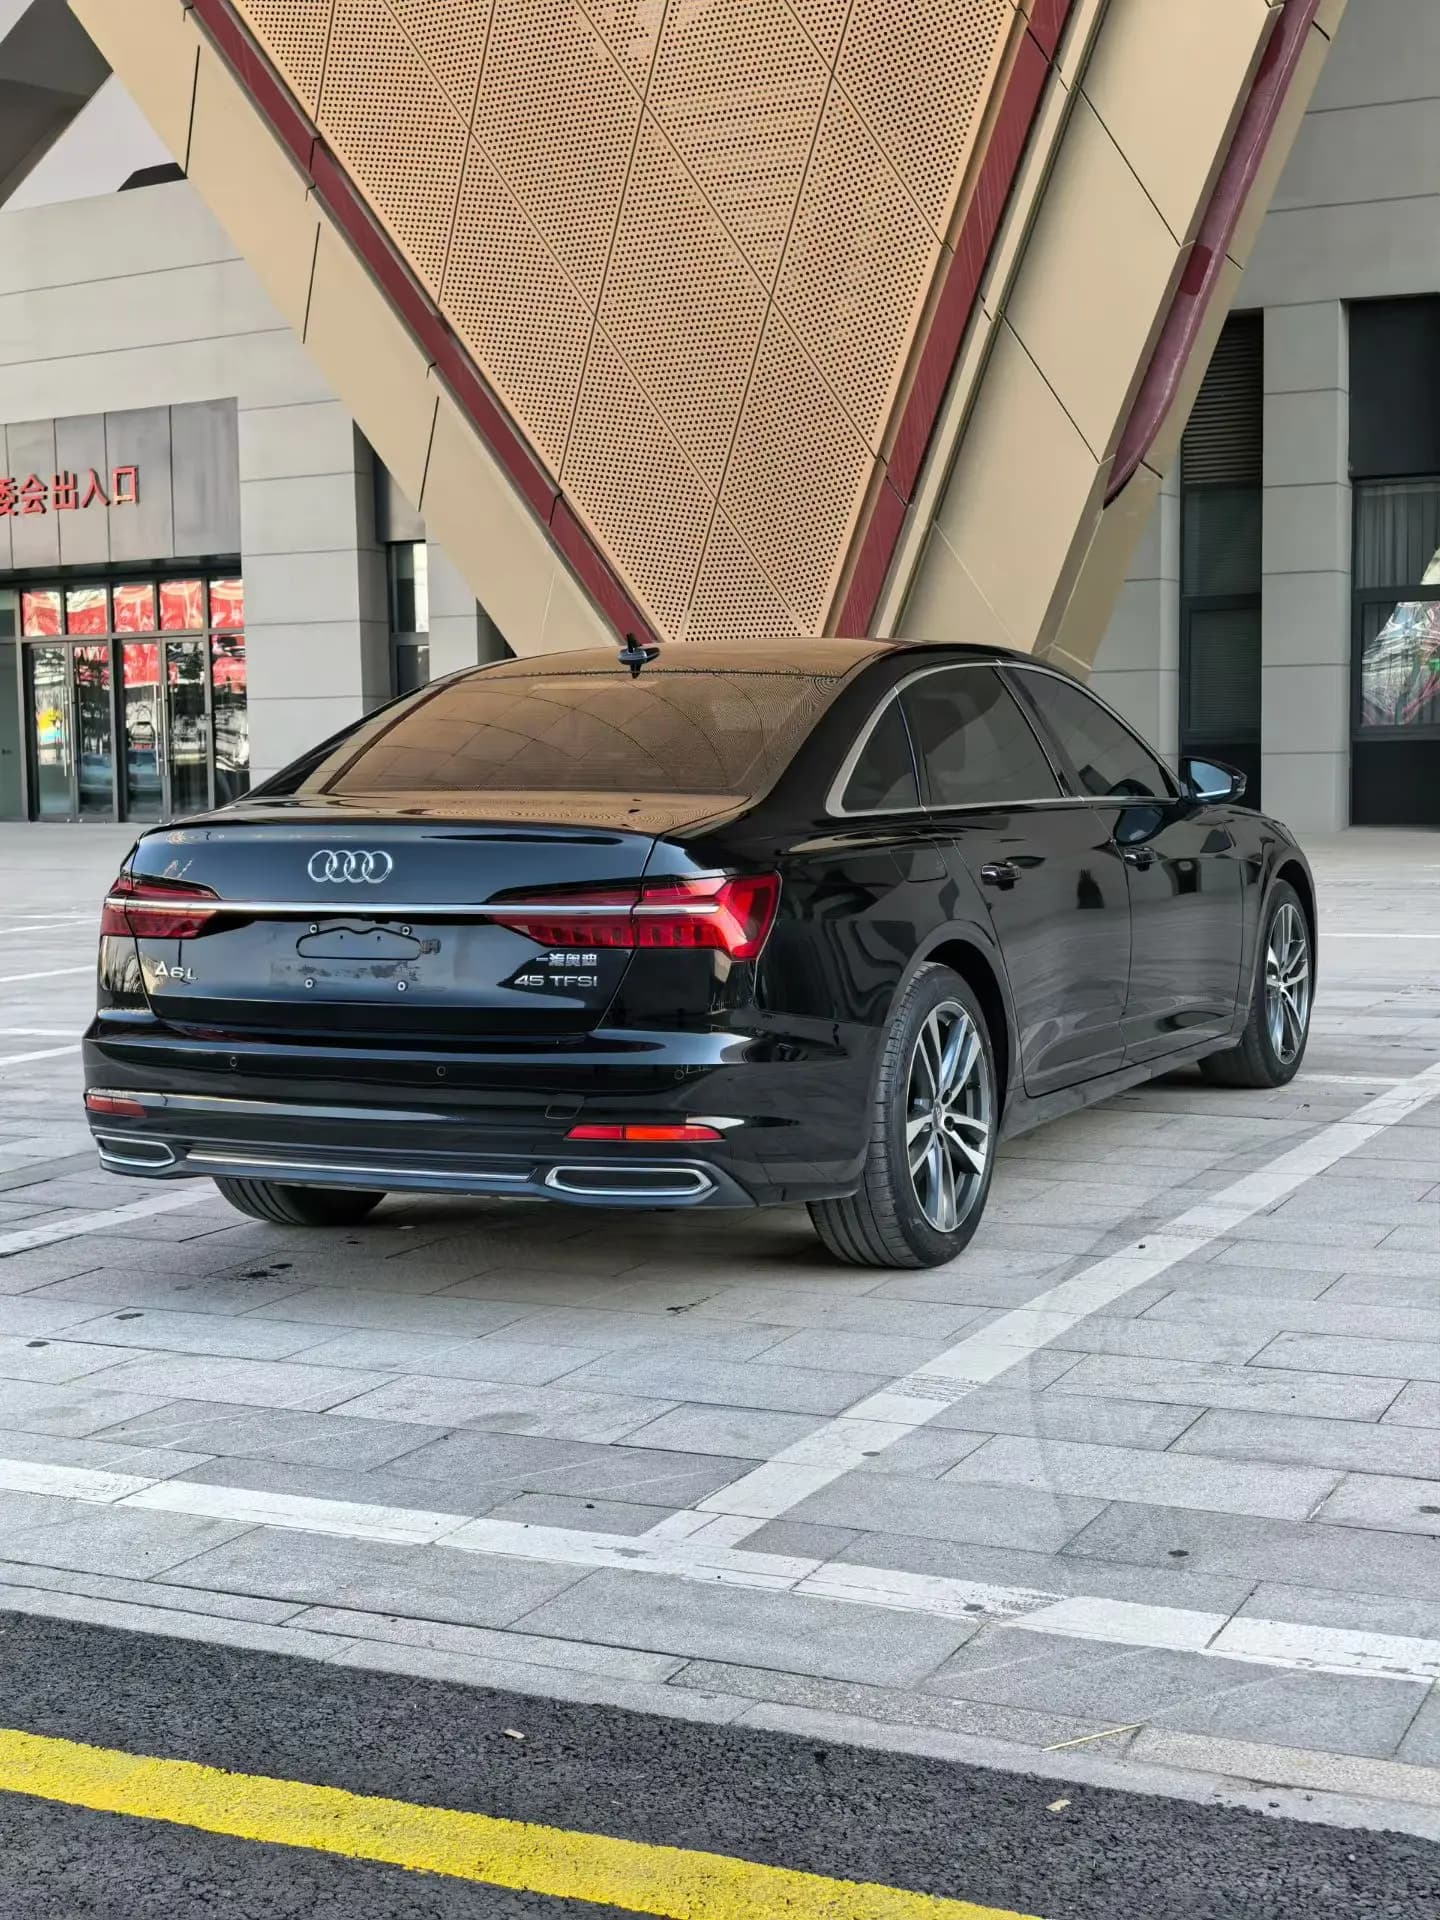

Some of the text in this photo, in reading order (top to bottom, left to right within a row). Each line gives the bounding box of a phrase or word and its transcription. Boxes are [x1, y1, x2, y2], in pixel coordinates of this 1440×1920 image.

[155, 960, 197, 980] A6L
[514, 974, 598, 988] 45 TFSI
